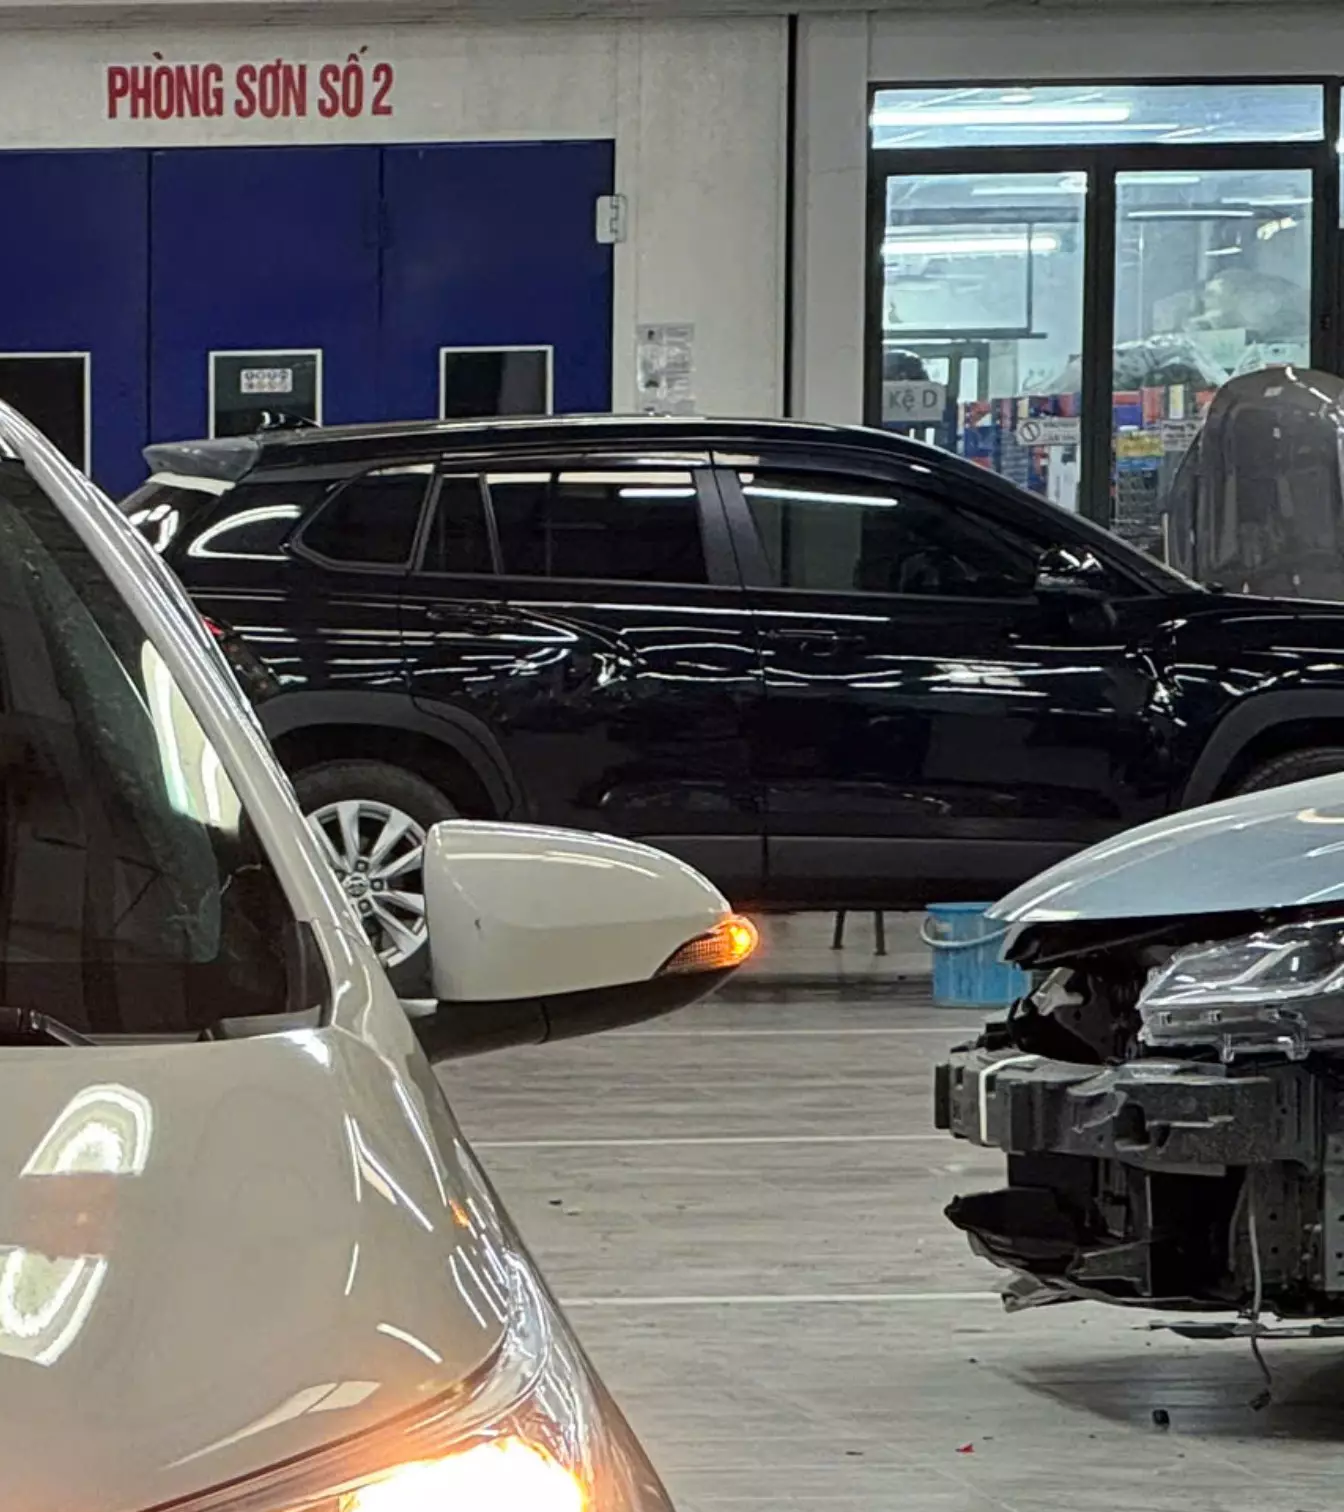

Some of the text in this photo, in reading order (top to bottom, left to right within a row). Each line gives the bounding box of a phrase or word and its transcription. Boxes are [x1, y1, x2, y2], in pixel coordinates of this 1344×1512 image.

[107, 45, 394, 120] PHÒNG SƠN SỐ 2
[922, 389, 938, 408] D
